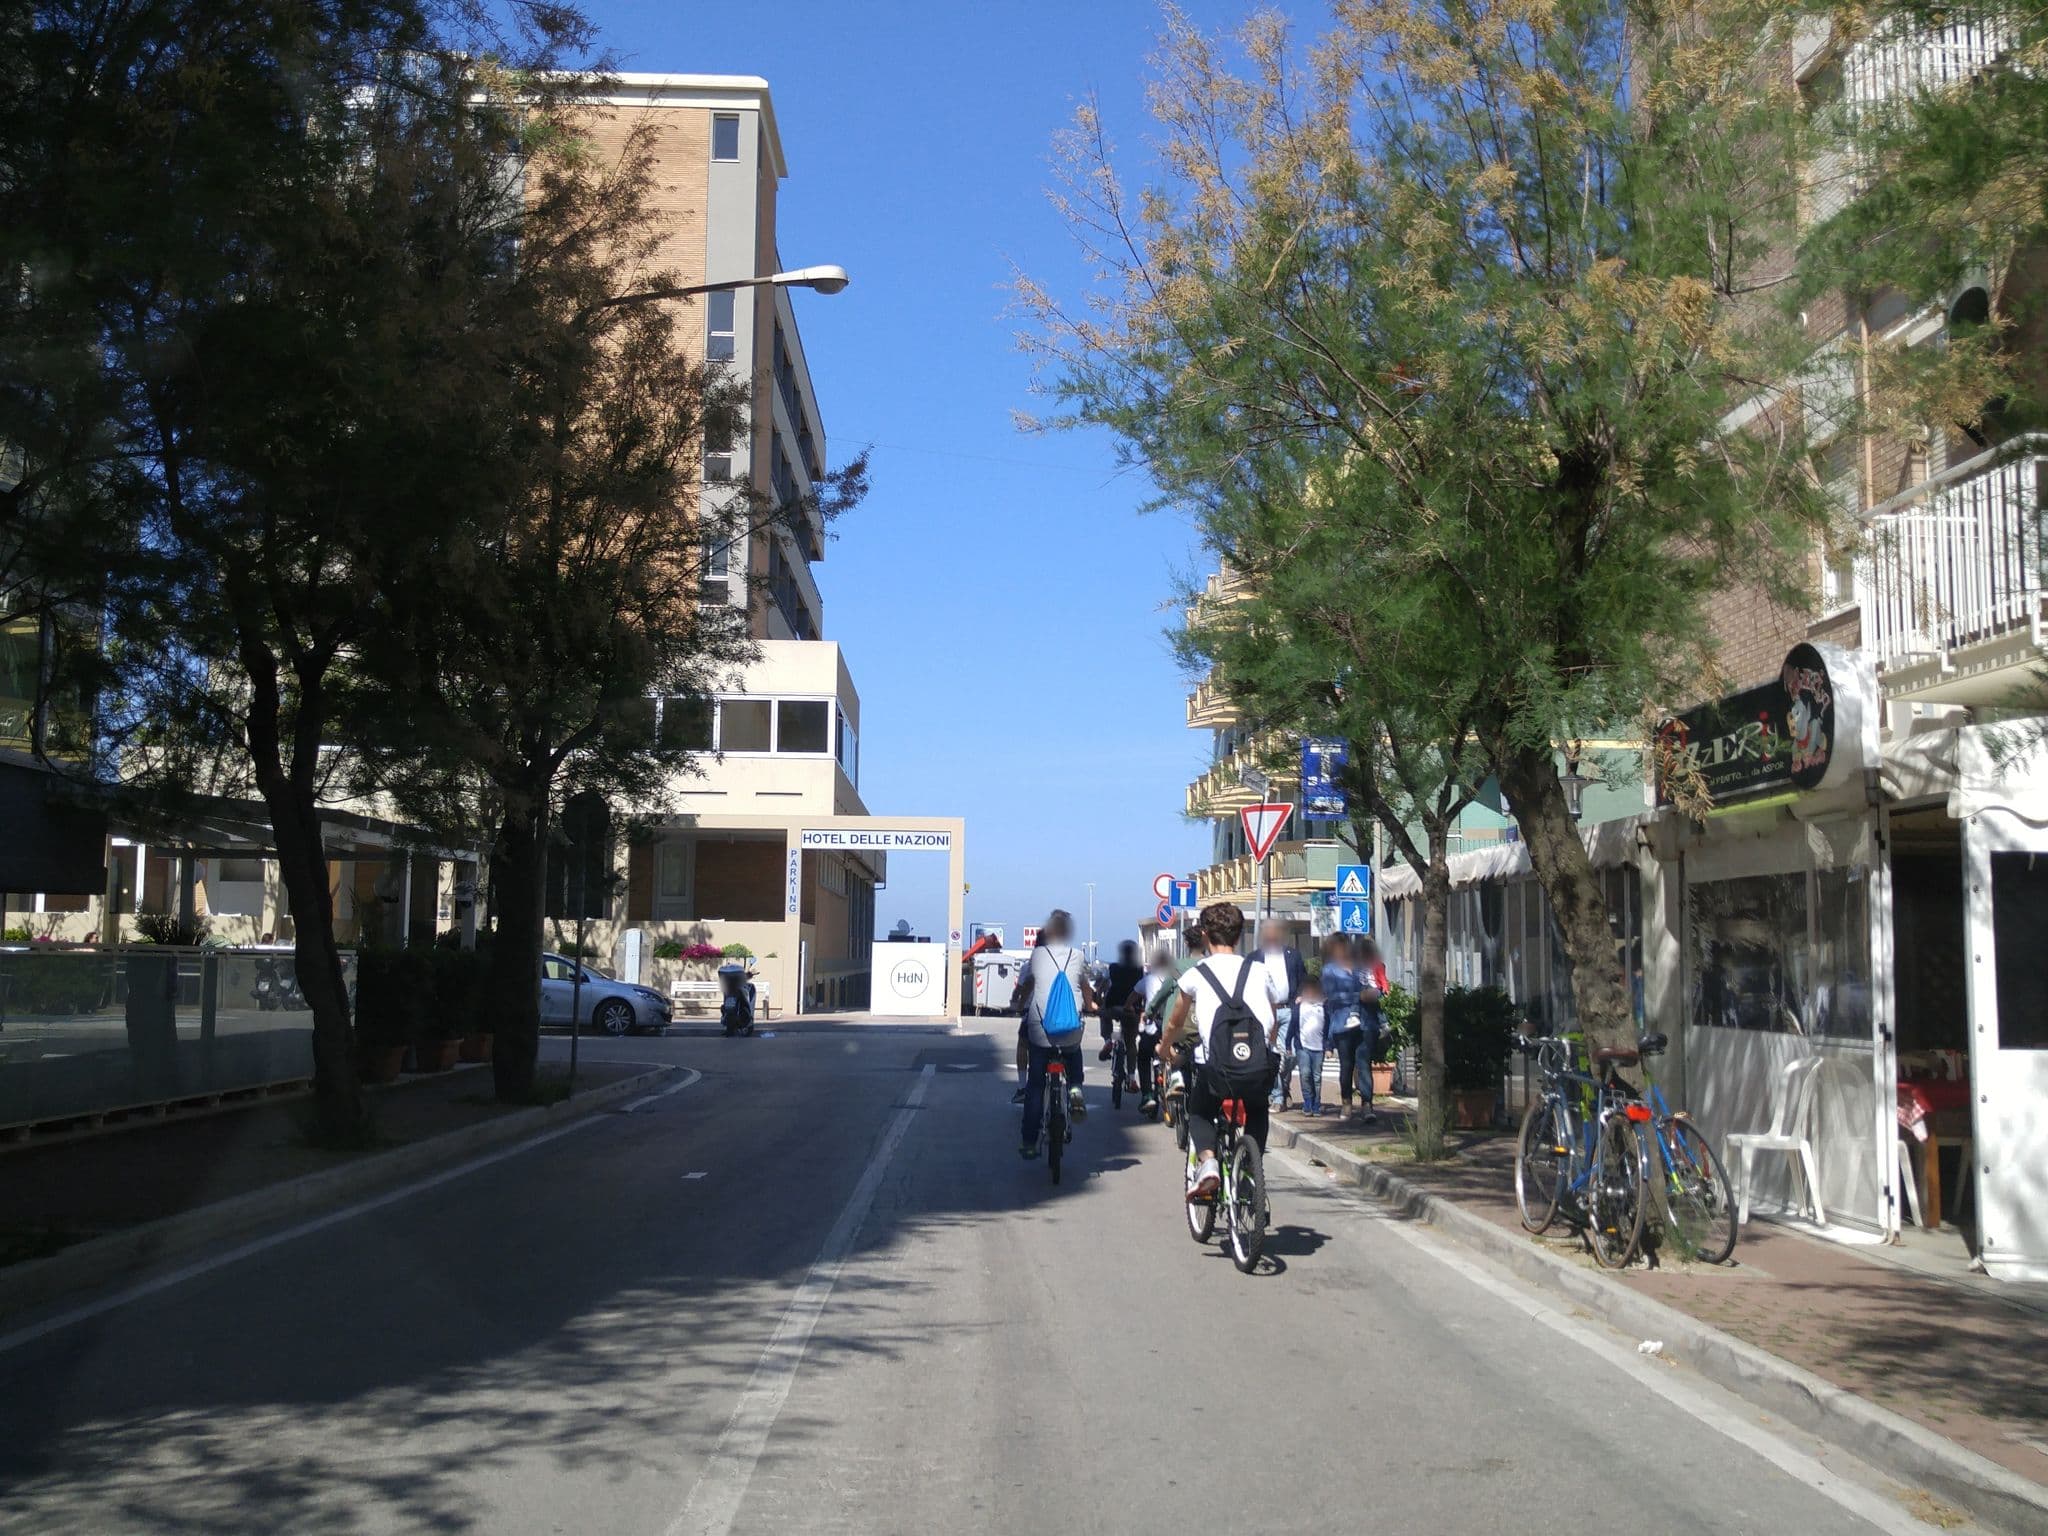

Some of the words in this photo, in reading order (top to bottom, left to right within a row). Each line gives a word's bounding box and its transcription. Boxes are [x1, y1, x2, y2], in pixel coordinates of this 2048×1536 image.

[803, 833, 846, 844] HOTEL
[850, 834, 891, 845] DELLE
[895, 835, 949, 846] NAZIONI
[788, 850, 797, 913] PARKING
[897, 972, 923, 984] HdN
